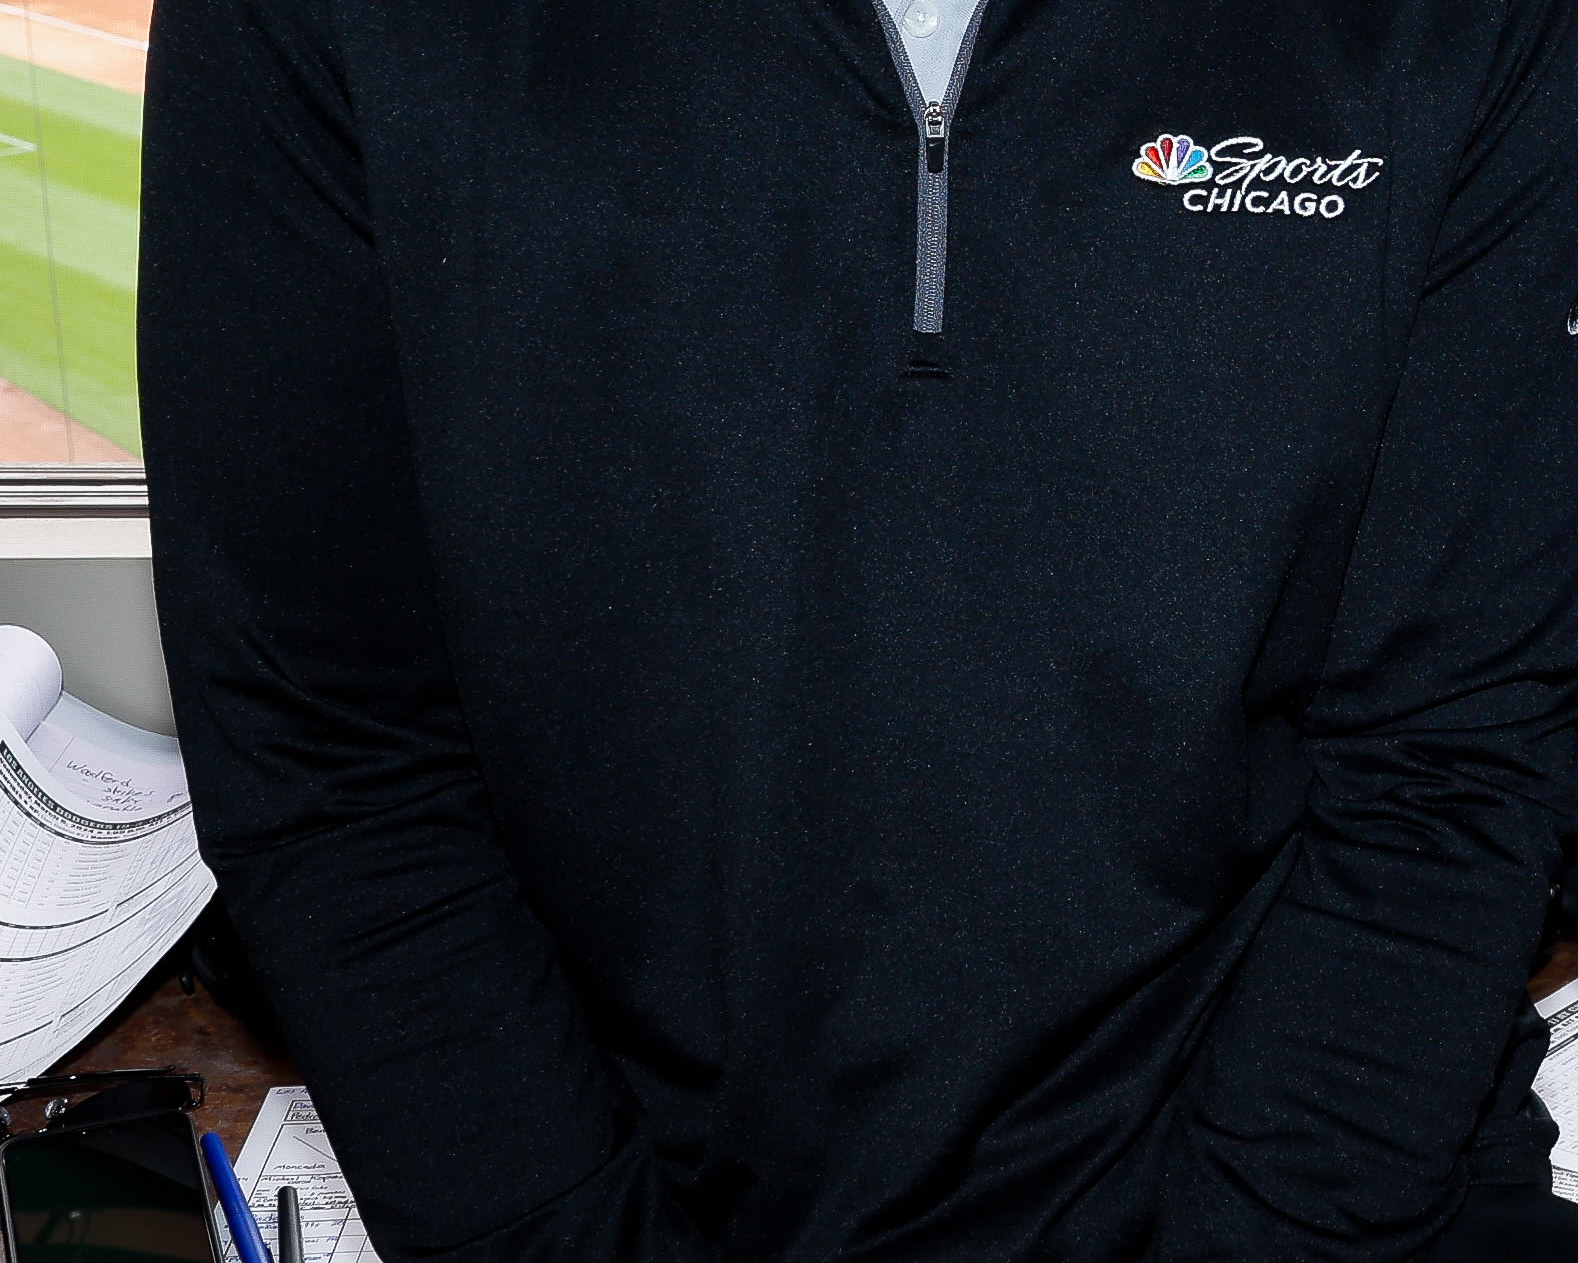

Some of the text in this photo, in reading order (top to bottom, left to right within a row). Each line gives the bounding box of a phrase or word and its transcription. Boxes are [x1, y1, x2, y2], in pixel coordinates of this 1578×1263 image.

[1209, 136, 1384, 195] Sports
[1182, 187, 1345, 219] CHICAGO
[55, 806, 113, 830] DODGERS
